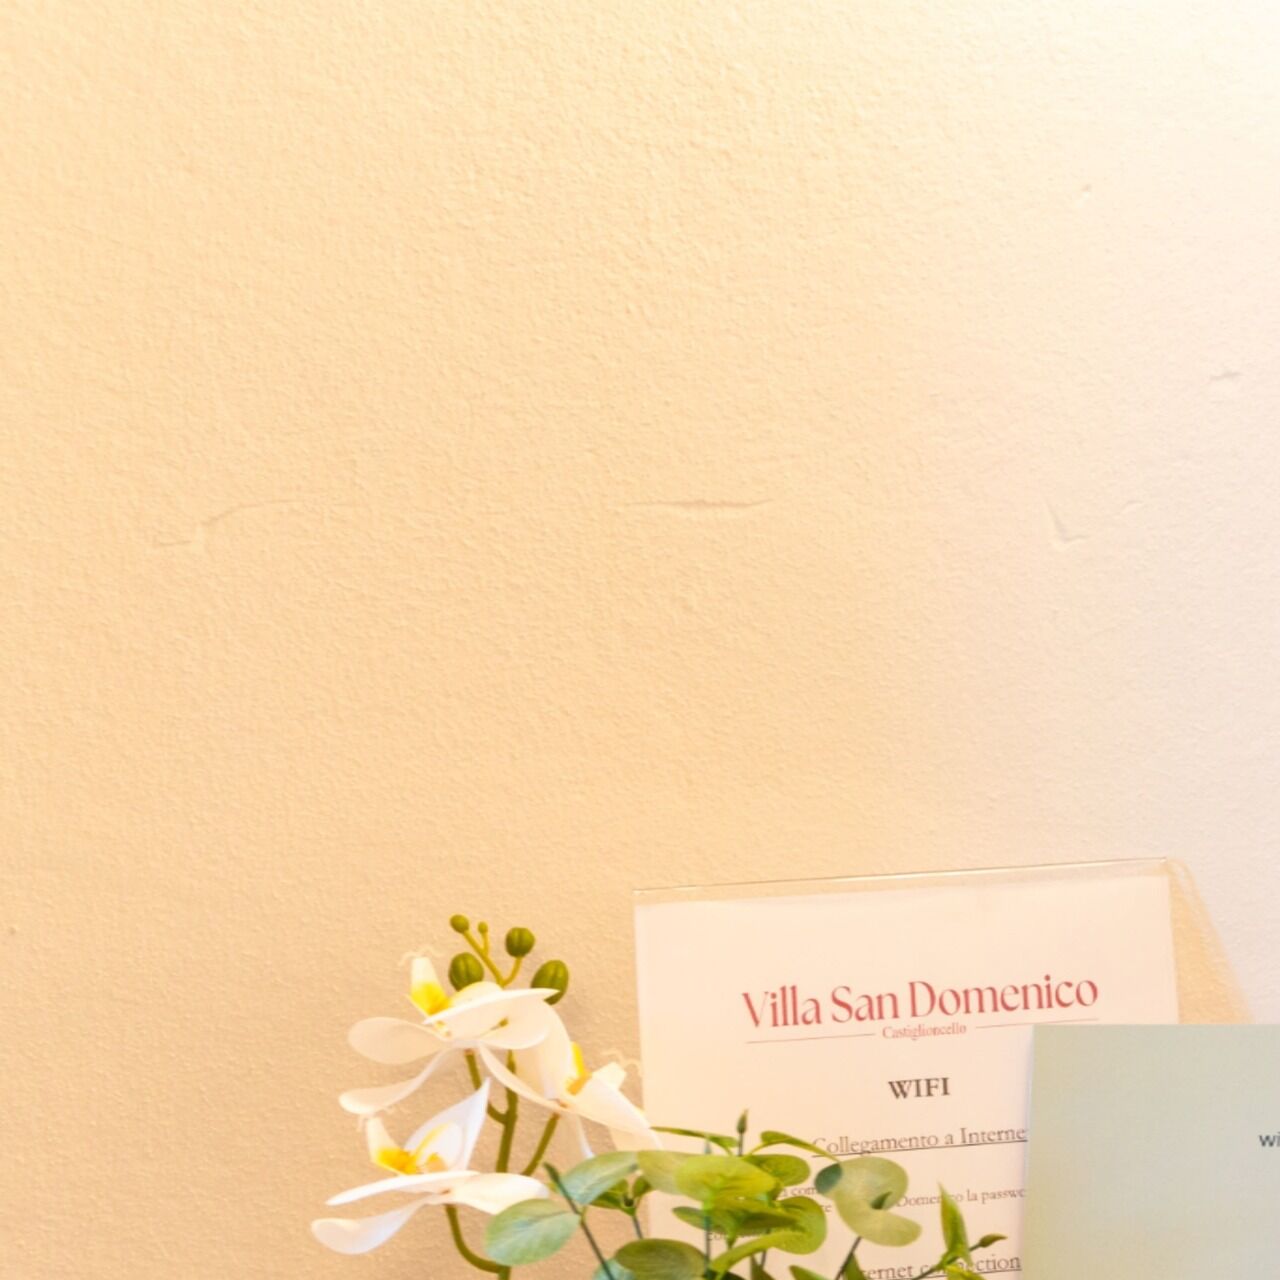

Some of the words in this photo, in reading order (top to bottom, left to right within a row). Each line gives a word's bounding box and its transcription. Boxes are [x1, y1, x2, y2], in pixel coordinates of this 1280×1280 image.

[742, 985, 821, 1028] Villa
[831, 986, 899, 1023] San
[908, 974, 1099, 1018] Domenico
[881, 1022, 968, 1041] Castiglioncello
[888, 1077, 950, 1100] WIFI
[944, 1135, 955, 1146] a
[960, 1127, 1026, 1146] Interne
